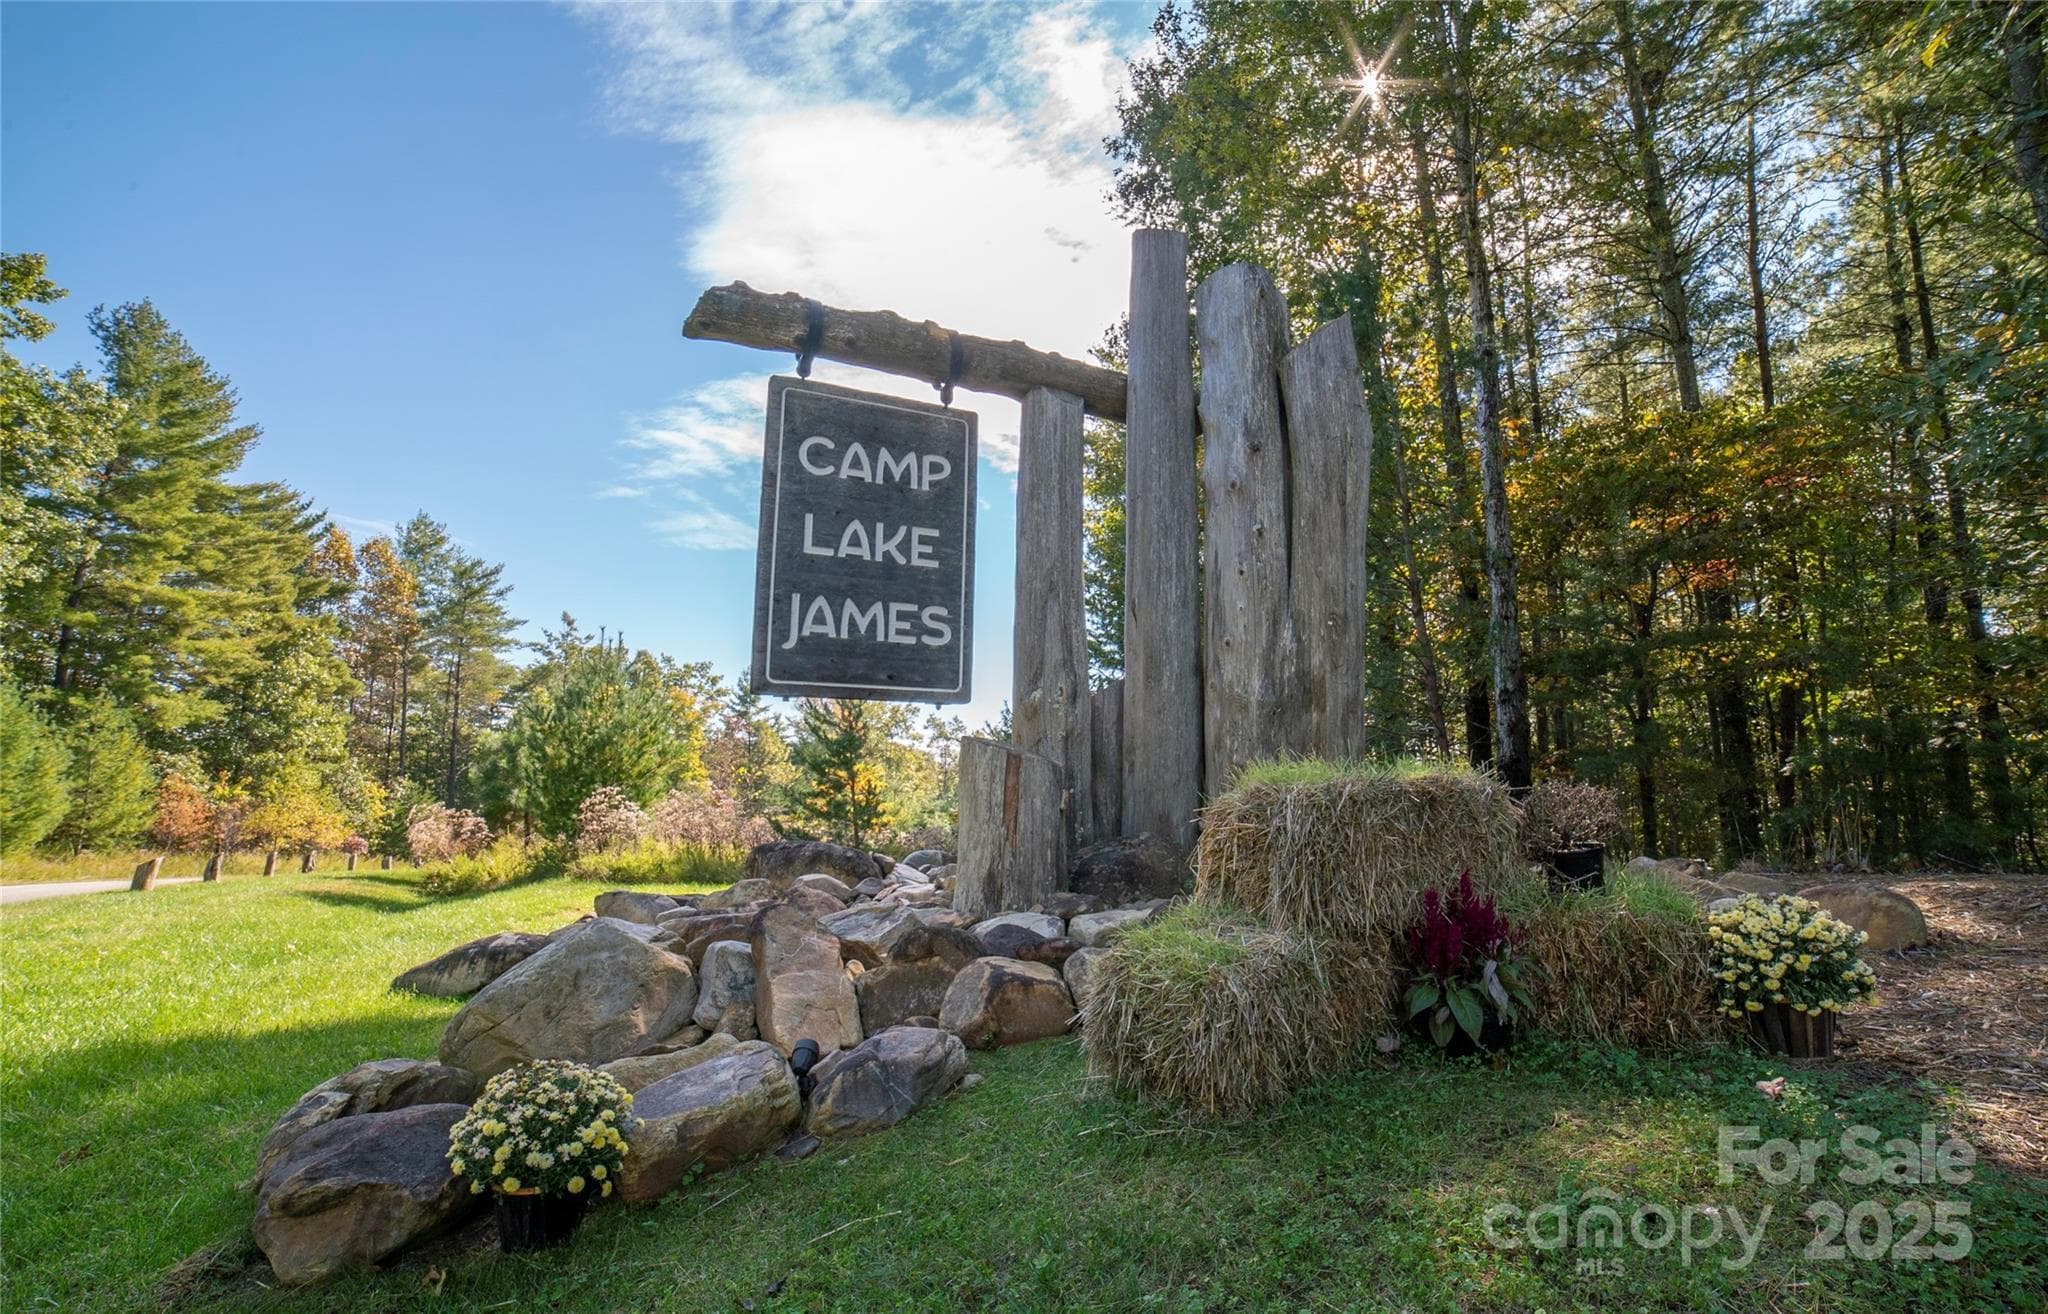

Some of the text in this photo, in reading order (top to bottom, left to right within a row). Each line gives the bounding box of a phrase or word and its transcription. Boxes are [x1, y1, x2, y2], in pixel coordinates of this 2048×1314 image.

[798, 435, 951, 491] CAMP
[803, 513, 940, 568] LAKE
[781, 593, 952, 649] JAMES
